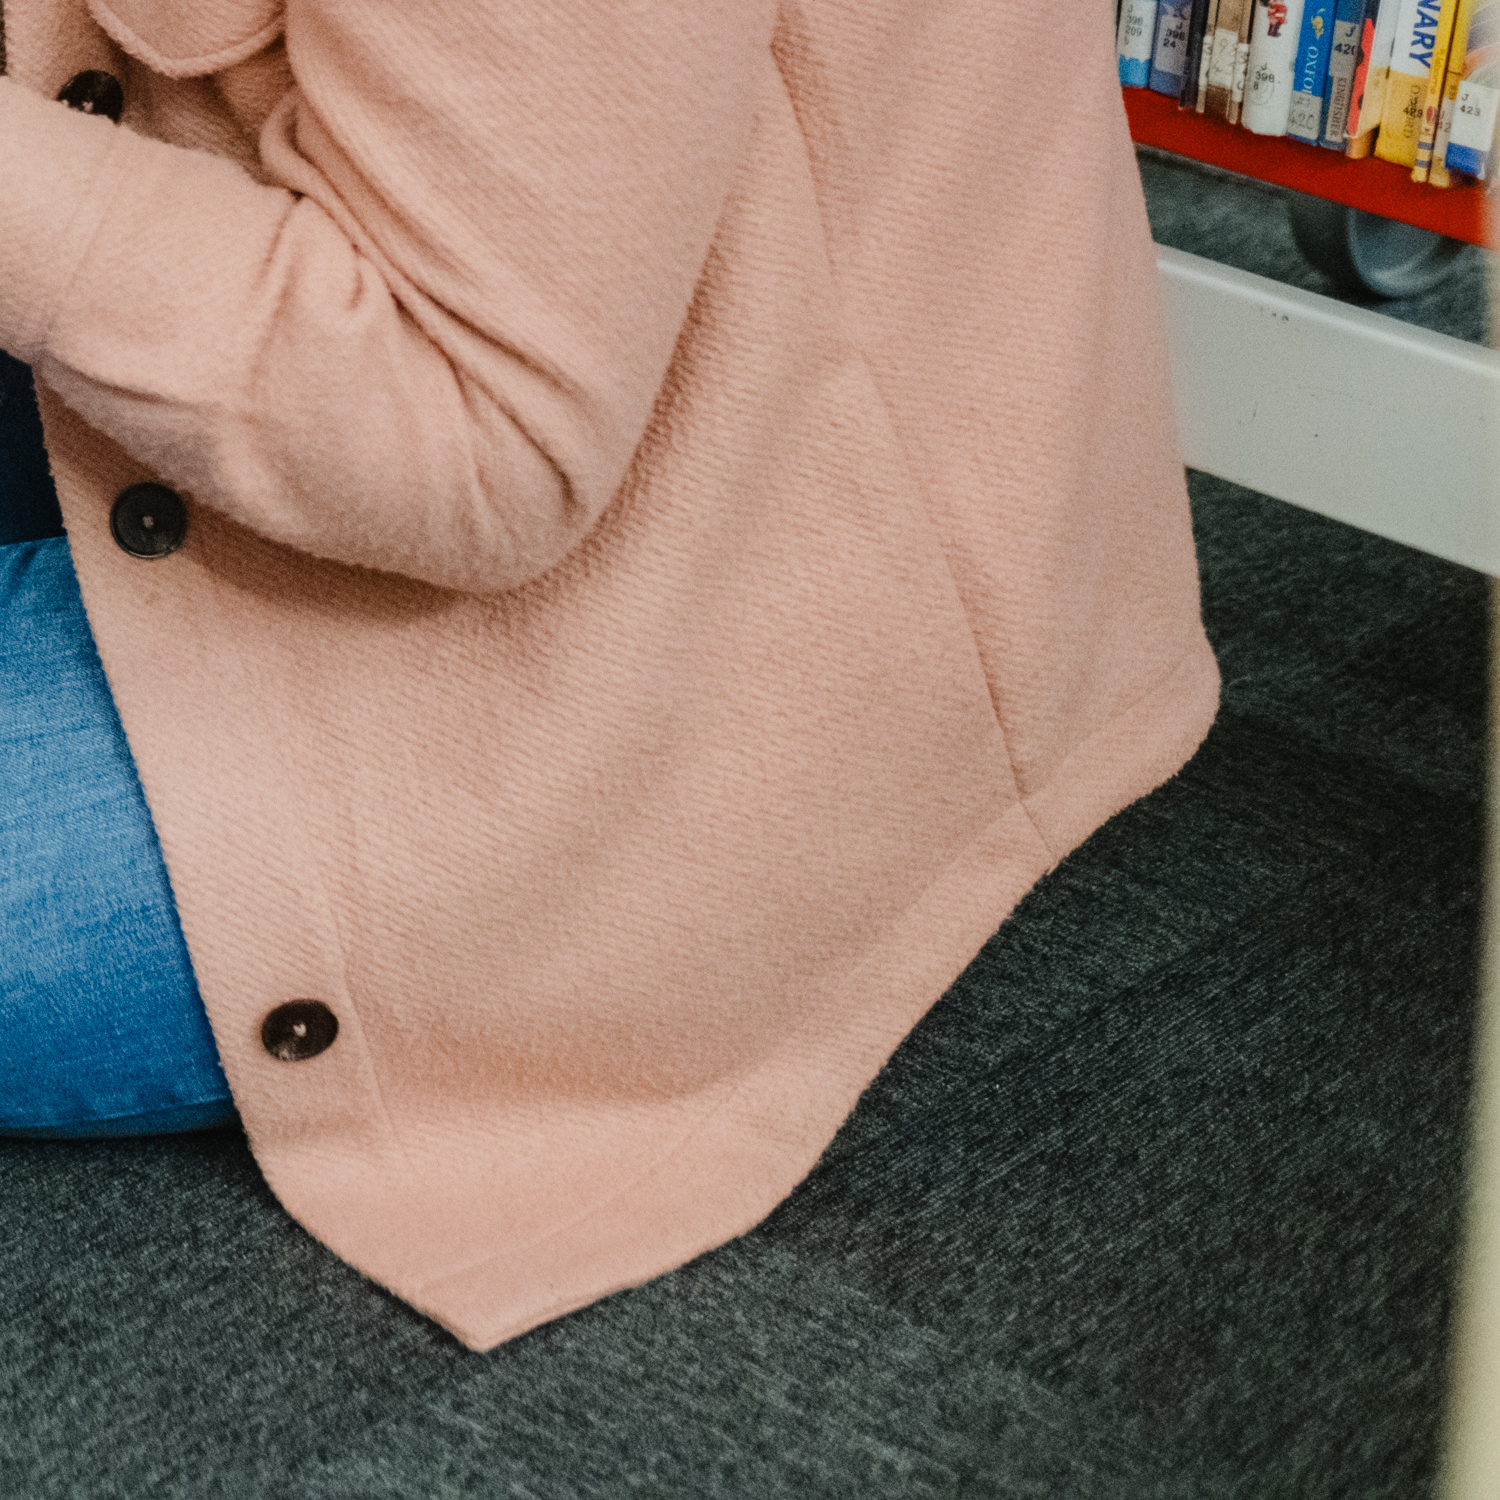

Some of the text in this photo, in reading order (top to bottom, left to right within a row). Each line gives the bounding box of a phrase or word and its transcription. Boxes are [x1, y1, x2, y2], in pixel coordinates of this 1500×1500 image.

[1345, 25, 1356, 38] J
[1163, 38, 1177, 49] 24
[1255, 71, 1275, 83] 398
[1461, 93, 1469, 102] J
[1330, 76, 1348, 138] KINGFISHER
[1459, 104, 1481, 117] 423
